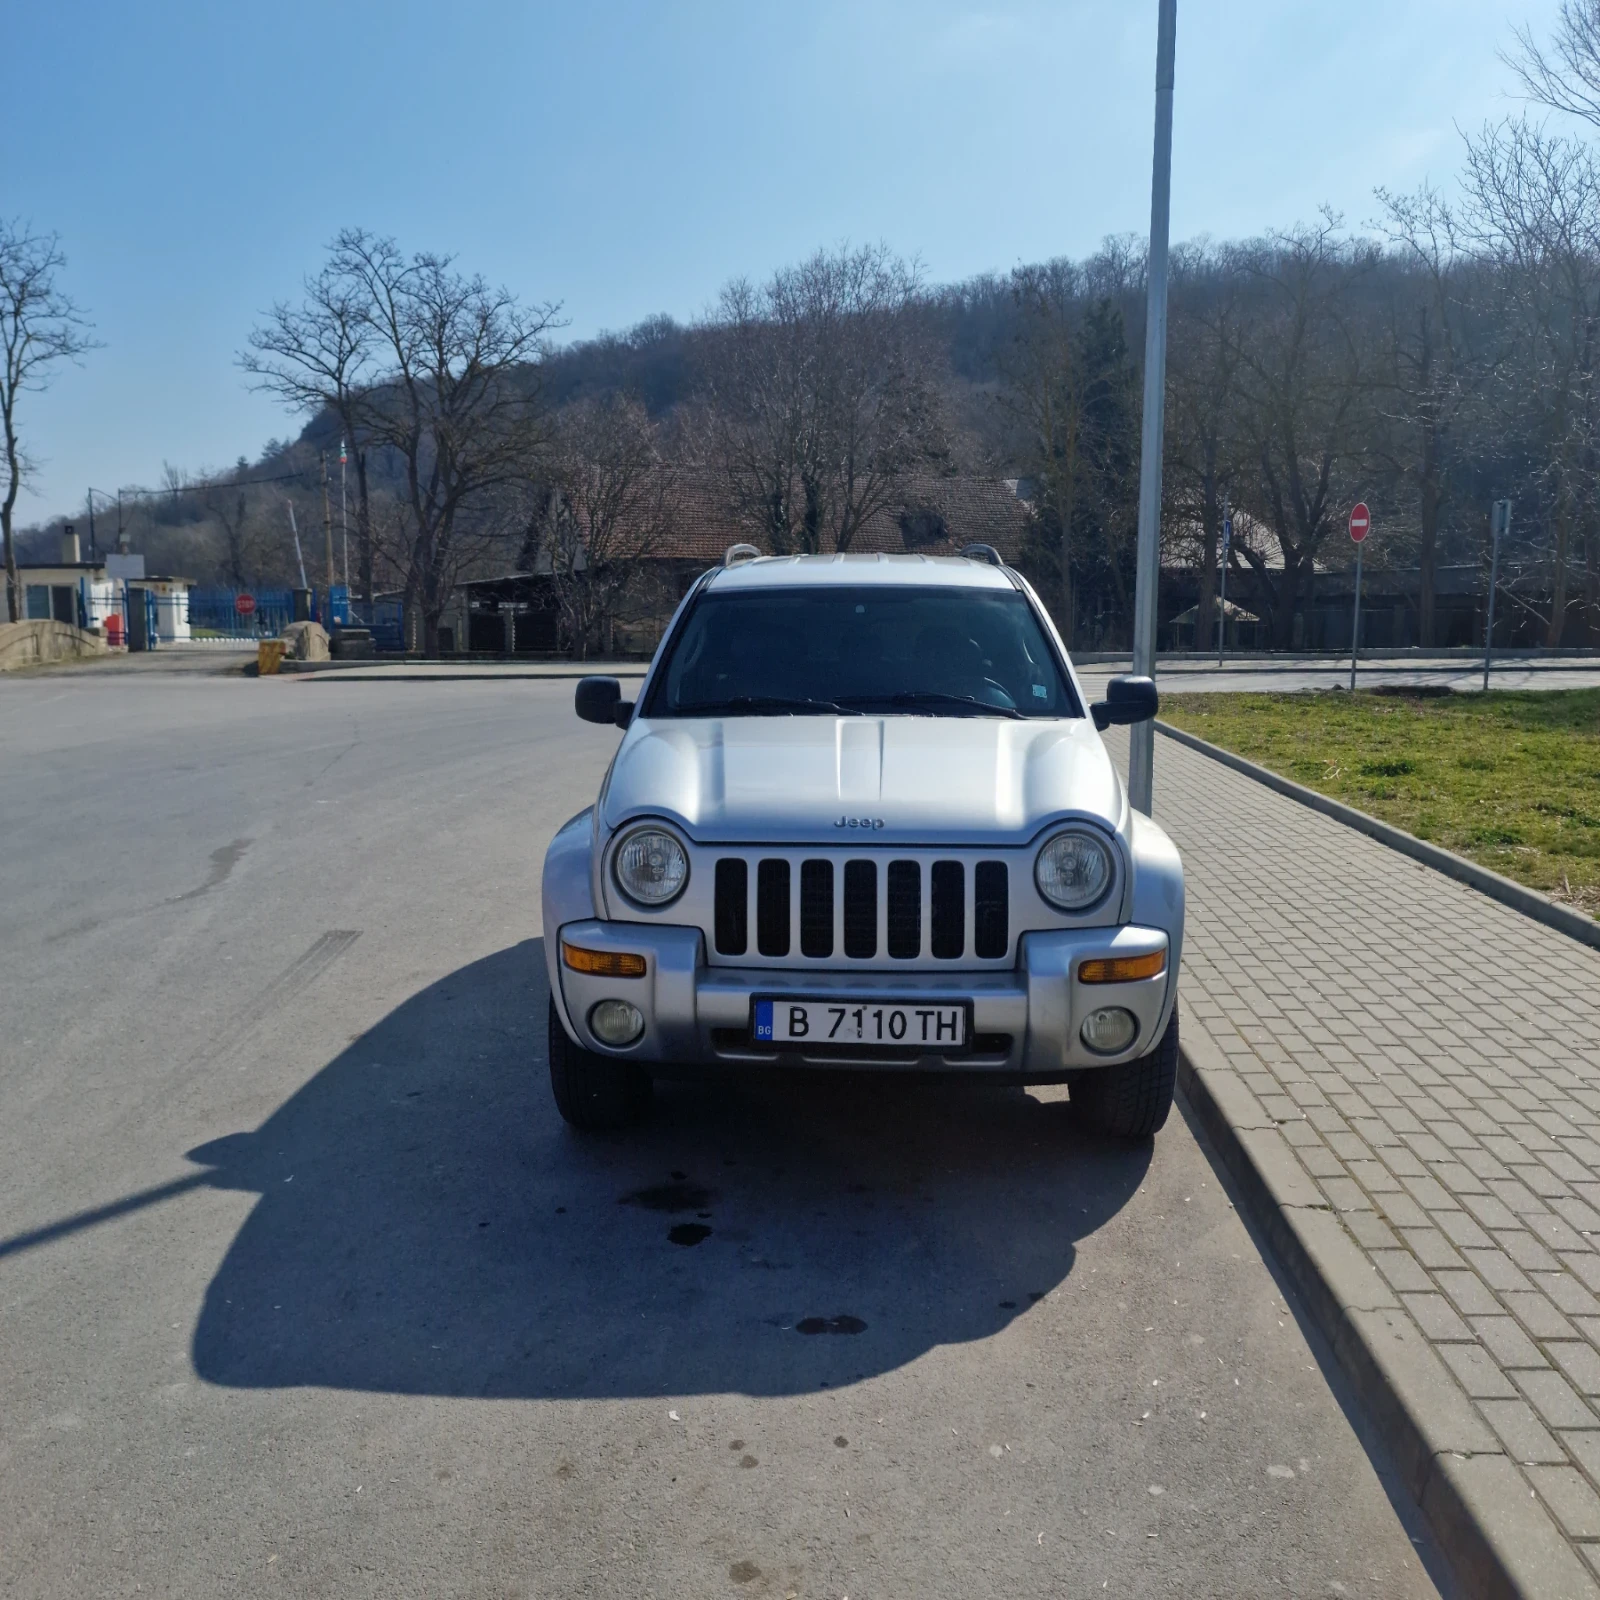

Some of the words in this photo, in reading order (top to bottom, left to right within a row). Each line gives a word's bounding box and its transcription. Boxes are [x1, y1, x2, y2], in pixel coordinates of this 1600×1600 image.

[834, 816, 885, 831] Jeep
[758, 1025, 771, 1035] BG
[789, 1006, 809, 1037] B
[828, 1008, 907, 1040] 7110
[915, 1010, 957, 1041] TH
